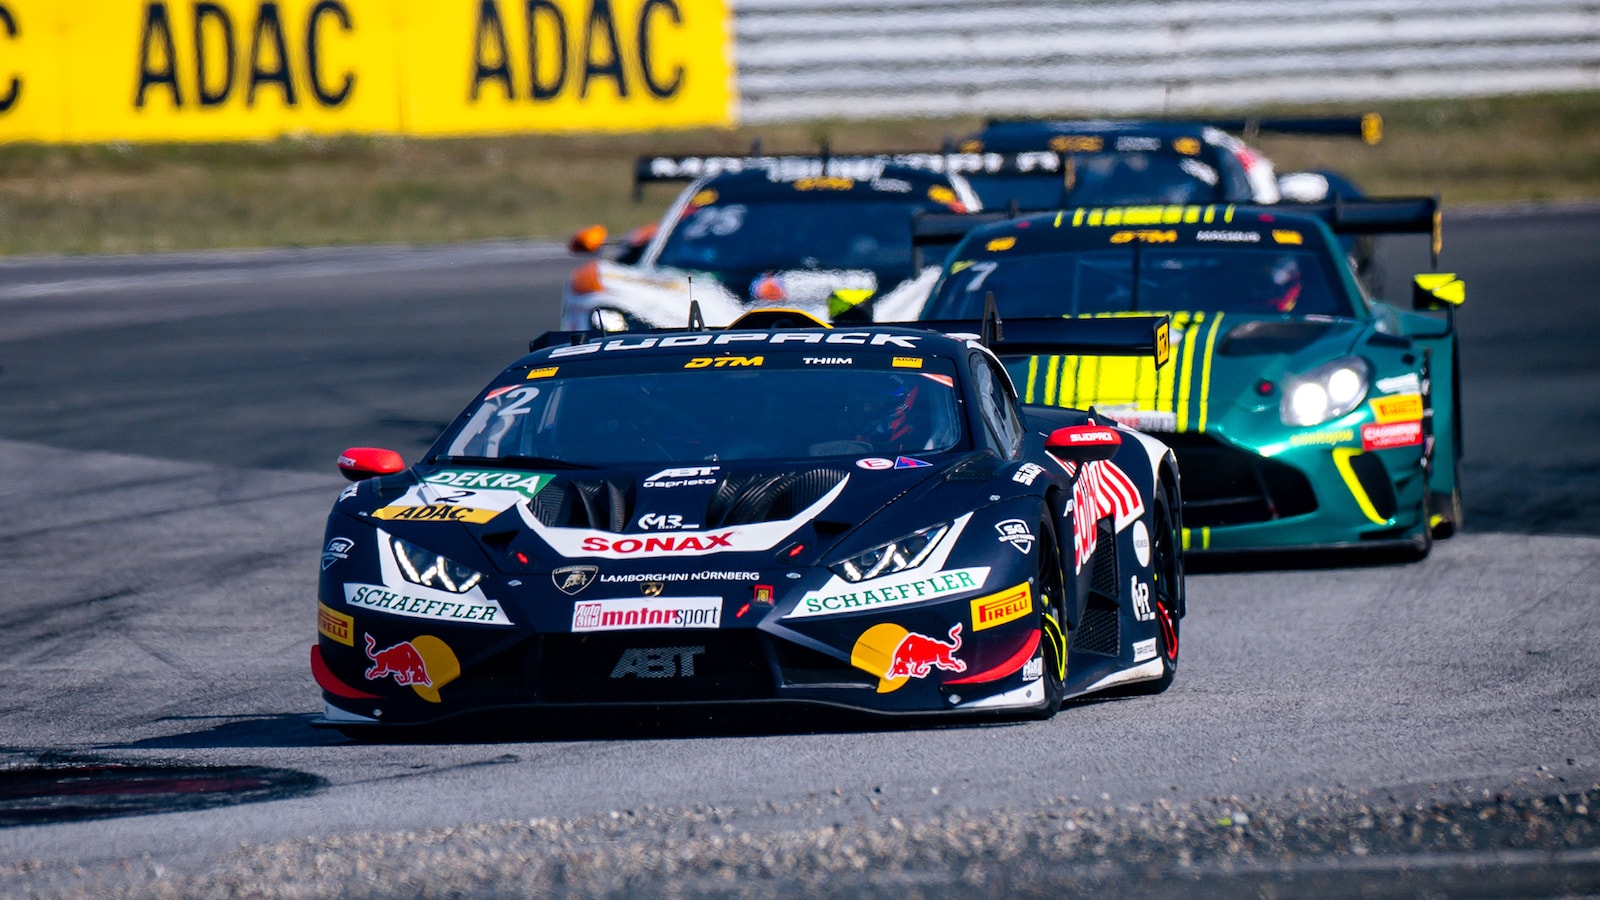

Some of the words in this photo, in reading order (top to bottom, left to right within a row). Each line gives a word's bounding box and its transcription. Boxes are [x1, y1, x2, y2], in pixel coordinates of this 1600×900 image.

[134, 0, 356, 108] ADAC
[468, 0, 686, 103] ADAC
[966, 262, 999, 292] 7
[684, 356, 764, 369] DTM
[803, 357, 853, 365] THIIM
[497, 387, 541, 417] 2
[424, 472, 540, 494] DEKRA
[645, 466, 721, 481] ABT
[435, 490, 477, 503] 2
[393, 505, 474, 520] ADAC
[581, 532, 735, 553] SONAX
[600, 573, 689, 583] LAMBORGHINI
[692, 571, 760, 581] NÜRNBERG
[806, 571, 976, 613] SCHAEFFLER
[351, 586, 498, 621] SCHAEFFLER
[978, 591, 1029, 623] PIRELLI
[601, 607, 718, 627] motorsport
[609, 646, 706, 679] ABT
